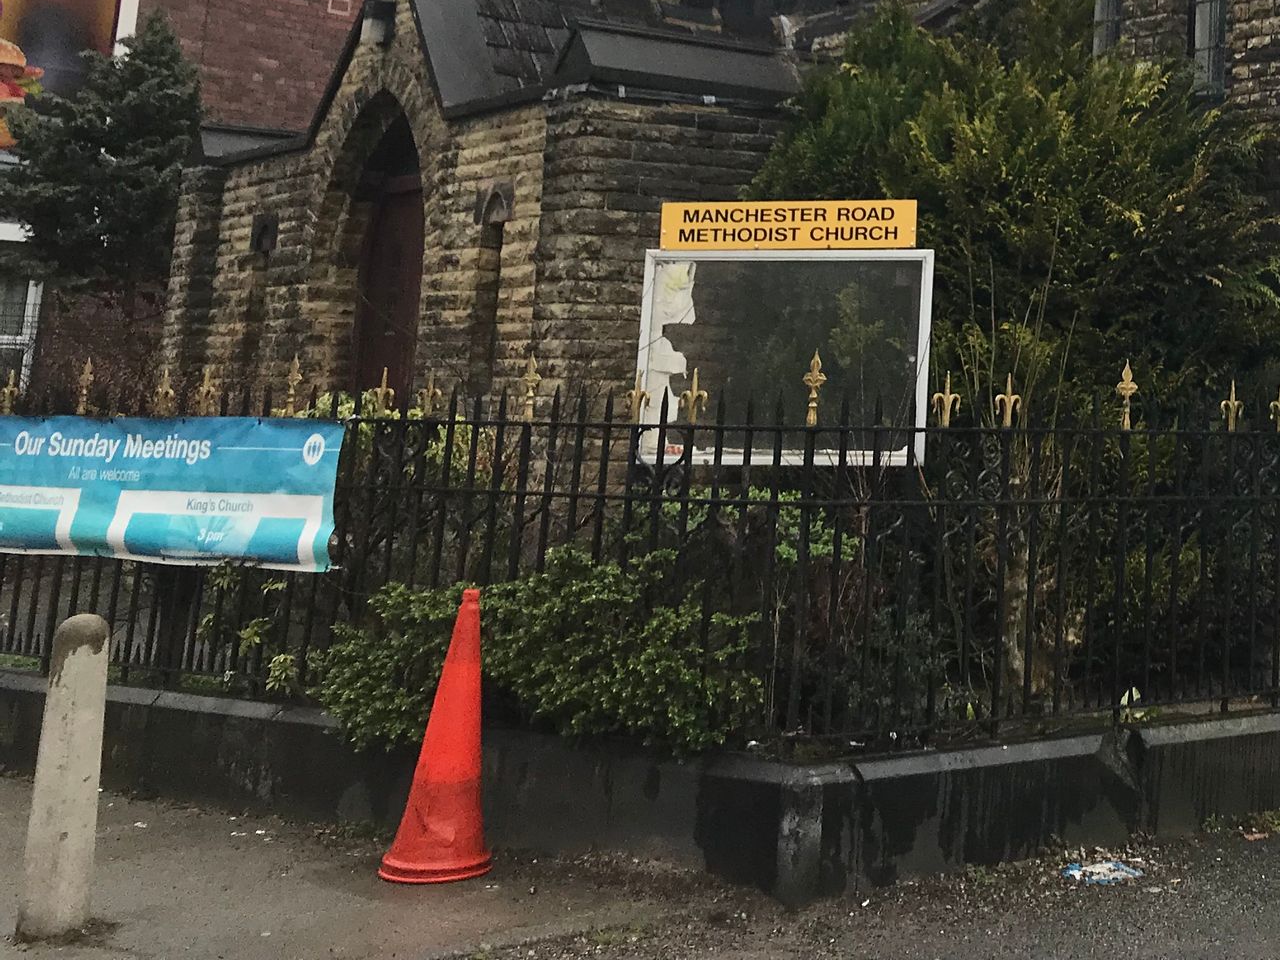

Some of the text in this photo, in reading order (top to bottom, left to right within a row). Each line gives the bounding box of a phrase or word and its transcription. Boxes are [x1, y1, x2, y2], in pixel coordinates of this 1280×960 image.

[682, 206, 895, 224] MANCHESTER ROAD
[678, 225, 899, 243] METHODIST CHURCH
[14, 430, 212, 465] Our Sunday Meetings
[67, 465, 140, 482] All are welcome
[33, 492, 64, 506] Church
[186, 497, 254, 514] King's Church
[197, 528, 224, 544] 3 pm
